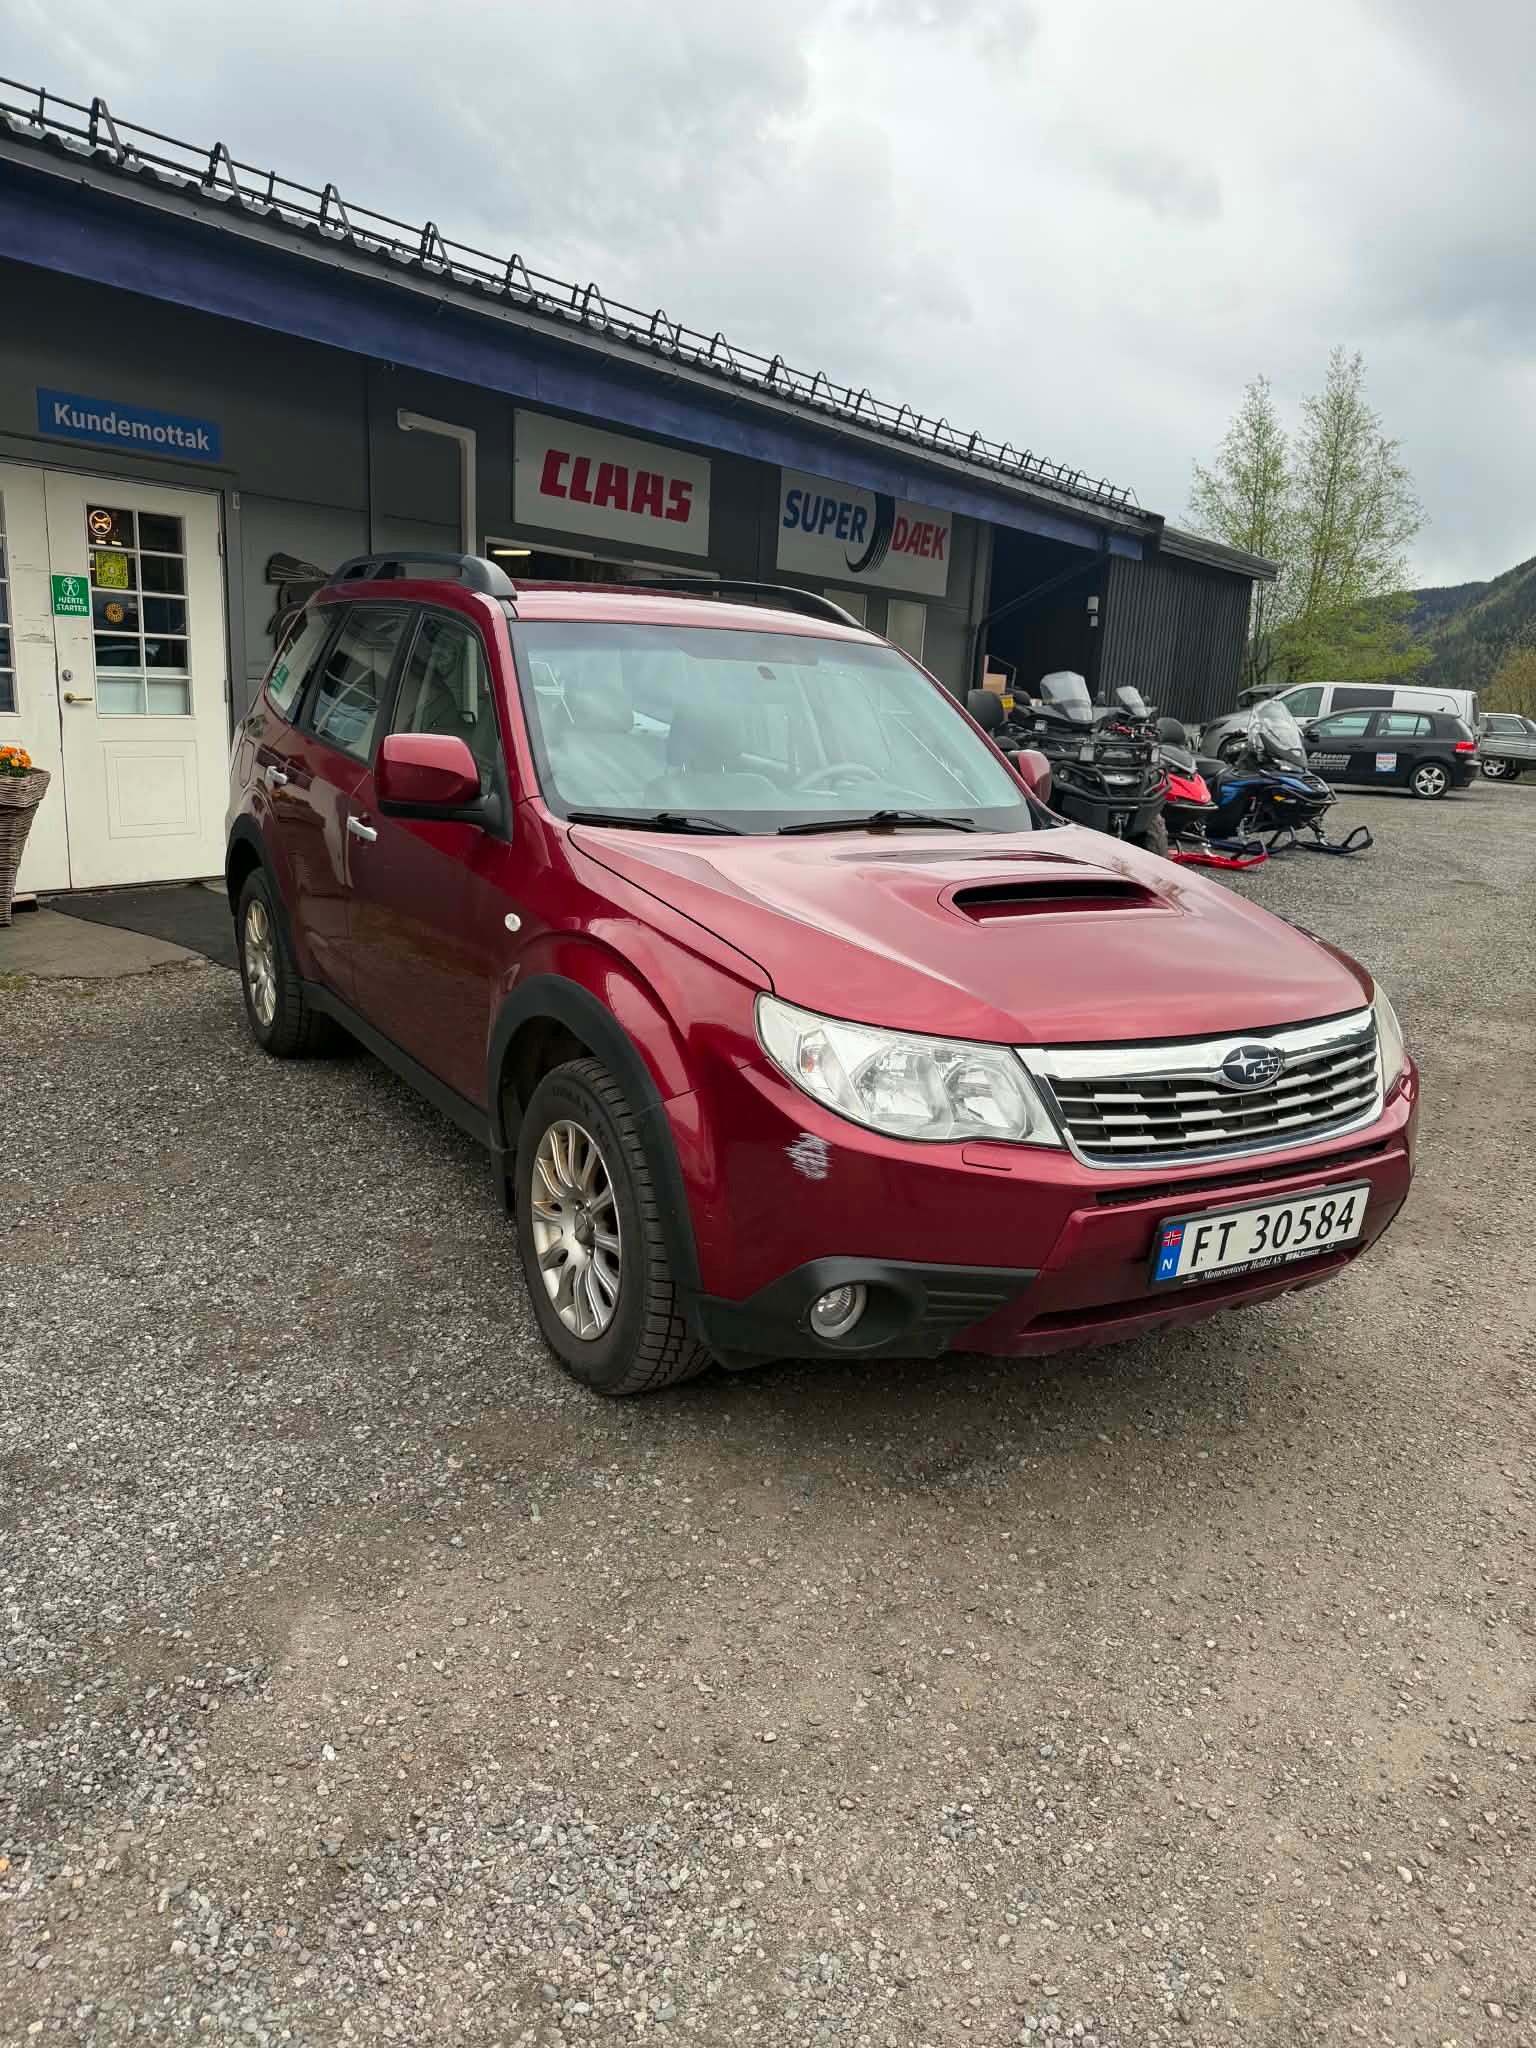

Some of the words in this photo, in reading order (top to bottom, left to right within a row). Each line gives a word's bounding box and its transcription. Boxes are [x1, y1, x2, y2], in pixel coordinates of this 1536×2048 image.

[54, 402, 210, 451] Kundemottak
[540, 449, 693, 522] CLAAS
[783, 489, 868, 544] SUPER
[56, 604, 87, 612] STARTER
[58, 596, 85, 604] HJERTE
[1190, 1221, 1237, 1267] FT
[1249, 1196, 1356, 1254] 30584
[1161, 1260, 1173, 1270] N
